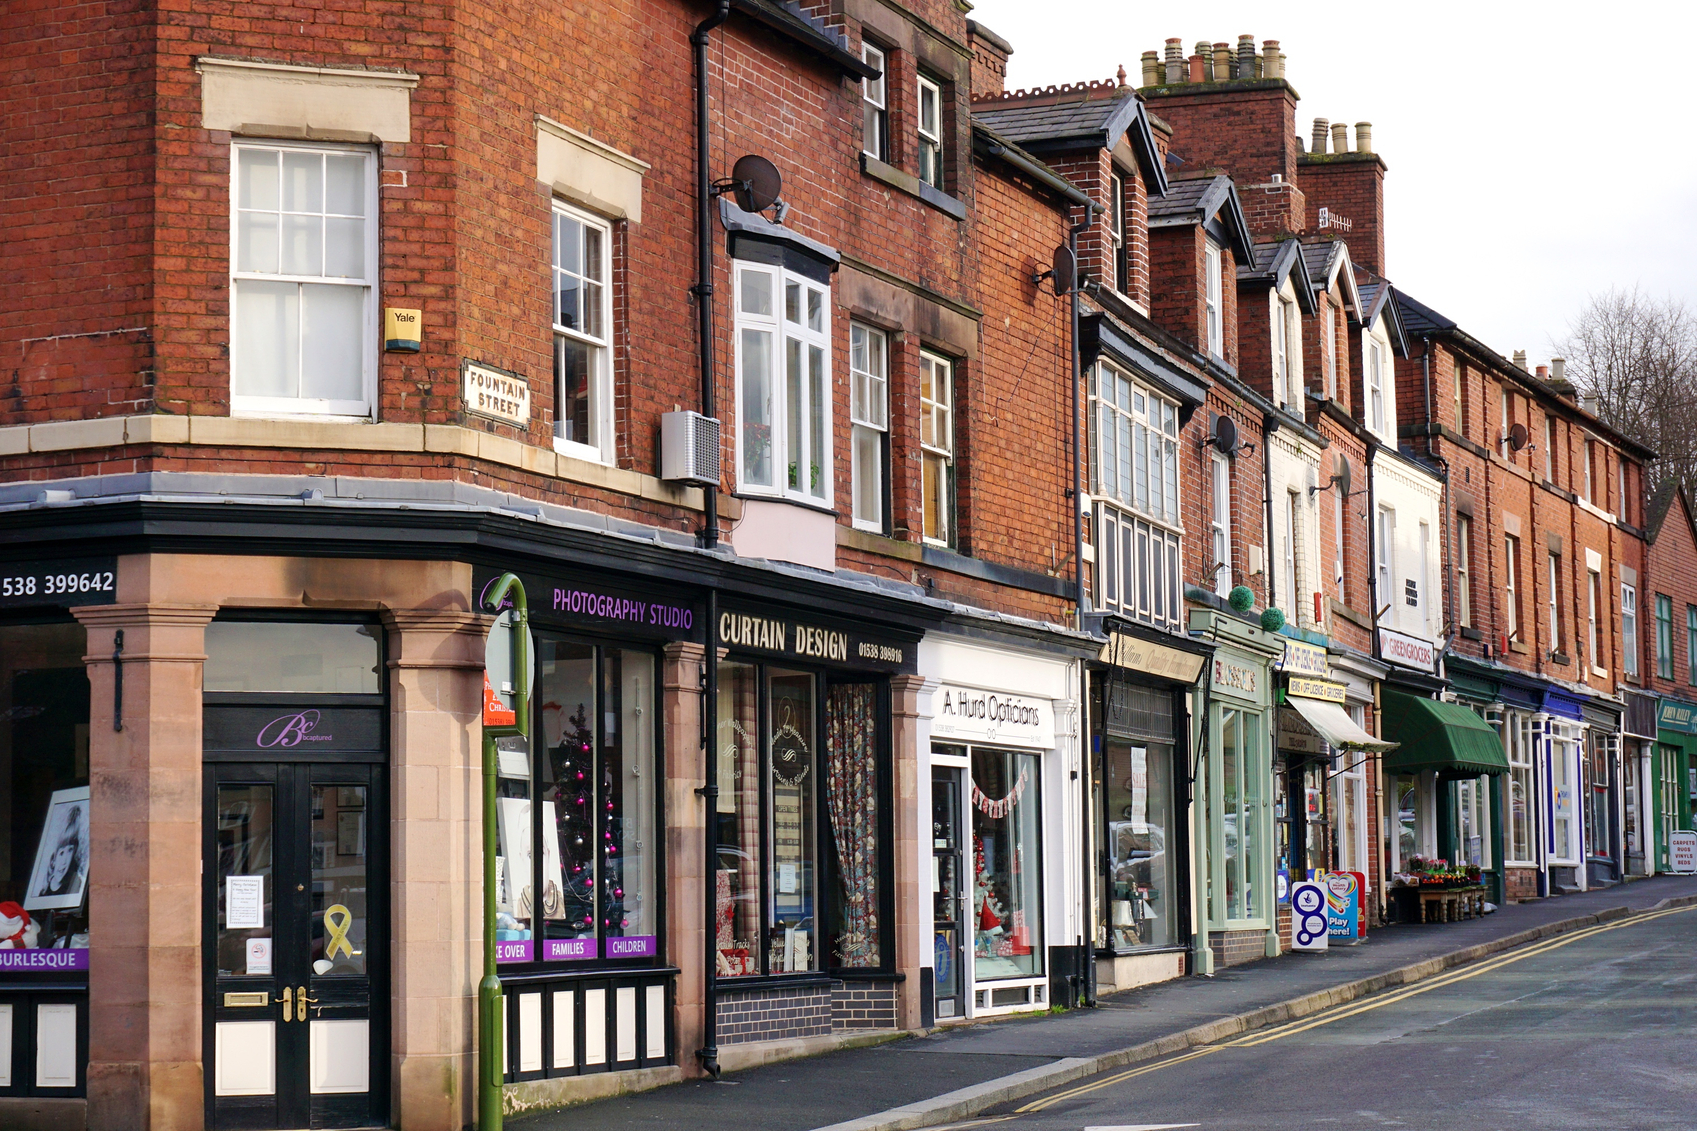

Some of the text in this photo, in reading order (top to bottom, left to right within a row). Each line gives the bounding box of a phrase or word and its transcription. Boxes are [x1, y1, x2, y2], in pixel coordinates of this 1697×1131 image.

[395, 312, 415, 323] Yale
[470, 371, 525, 400] FOUNTAIN
[478, 392, 521, 417] STREET
[44, 571, 114, 594] 399642
[553, 588, 693, 630] PHOTOGRAPHY STUDIO
[719, 612, 786, 651] CURTAIN
[795, 624, 848, 662] DESIGN
[858, 641, 879, 659] 01538
[1146, 648, 1170, 674] Quality
[1389, 637, 1431, 665] GREENGROCERS
[1215, 660, 1256, 692] BLOSSOMS
[958, 690, 986, 719] Hurd
[986, 695, 1039, 728] Opticians
[1661, 705, 1676, 721] JOHN
[302, 734, 333, 742] bcaptured
[1327, 927, 1350, 936] here!
[1329, 917, 1349, 928] Play
[504, 944, 525, 958] OVER
[552, 941, 584, 956] FAMILIES
[612, 939, 647, 954] CHILDREN
